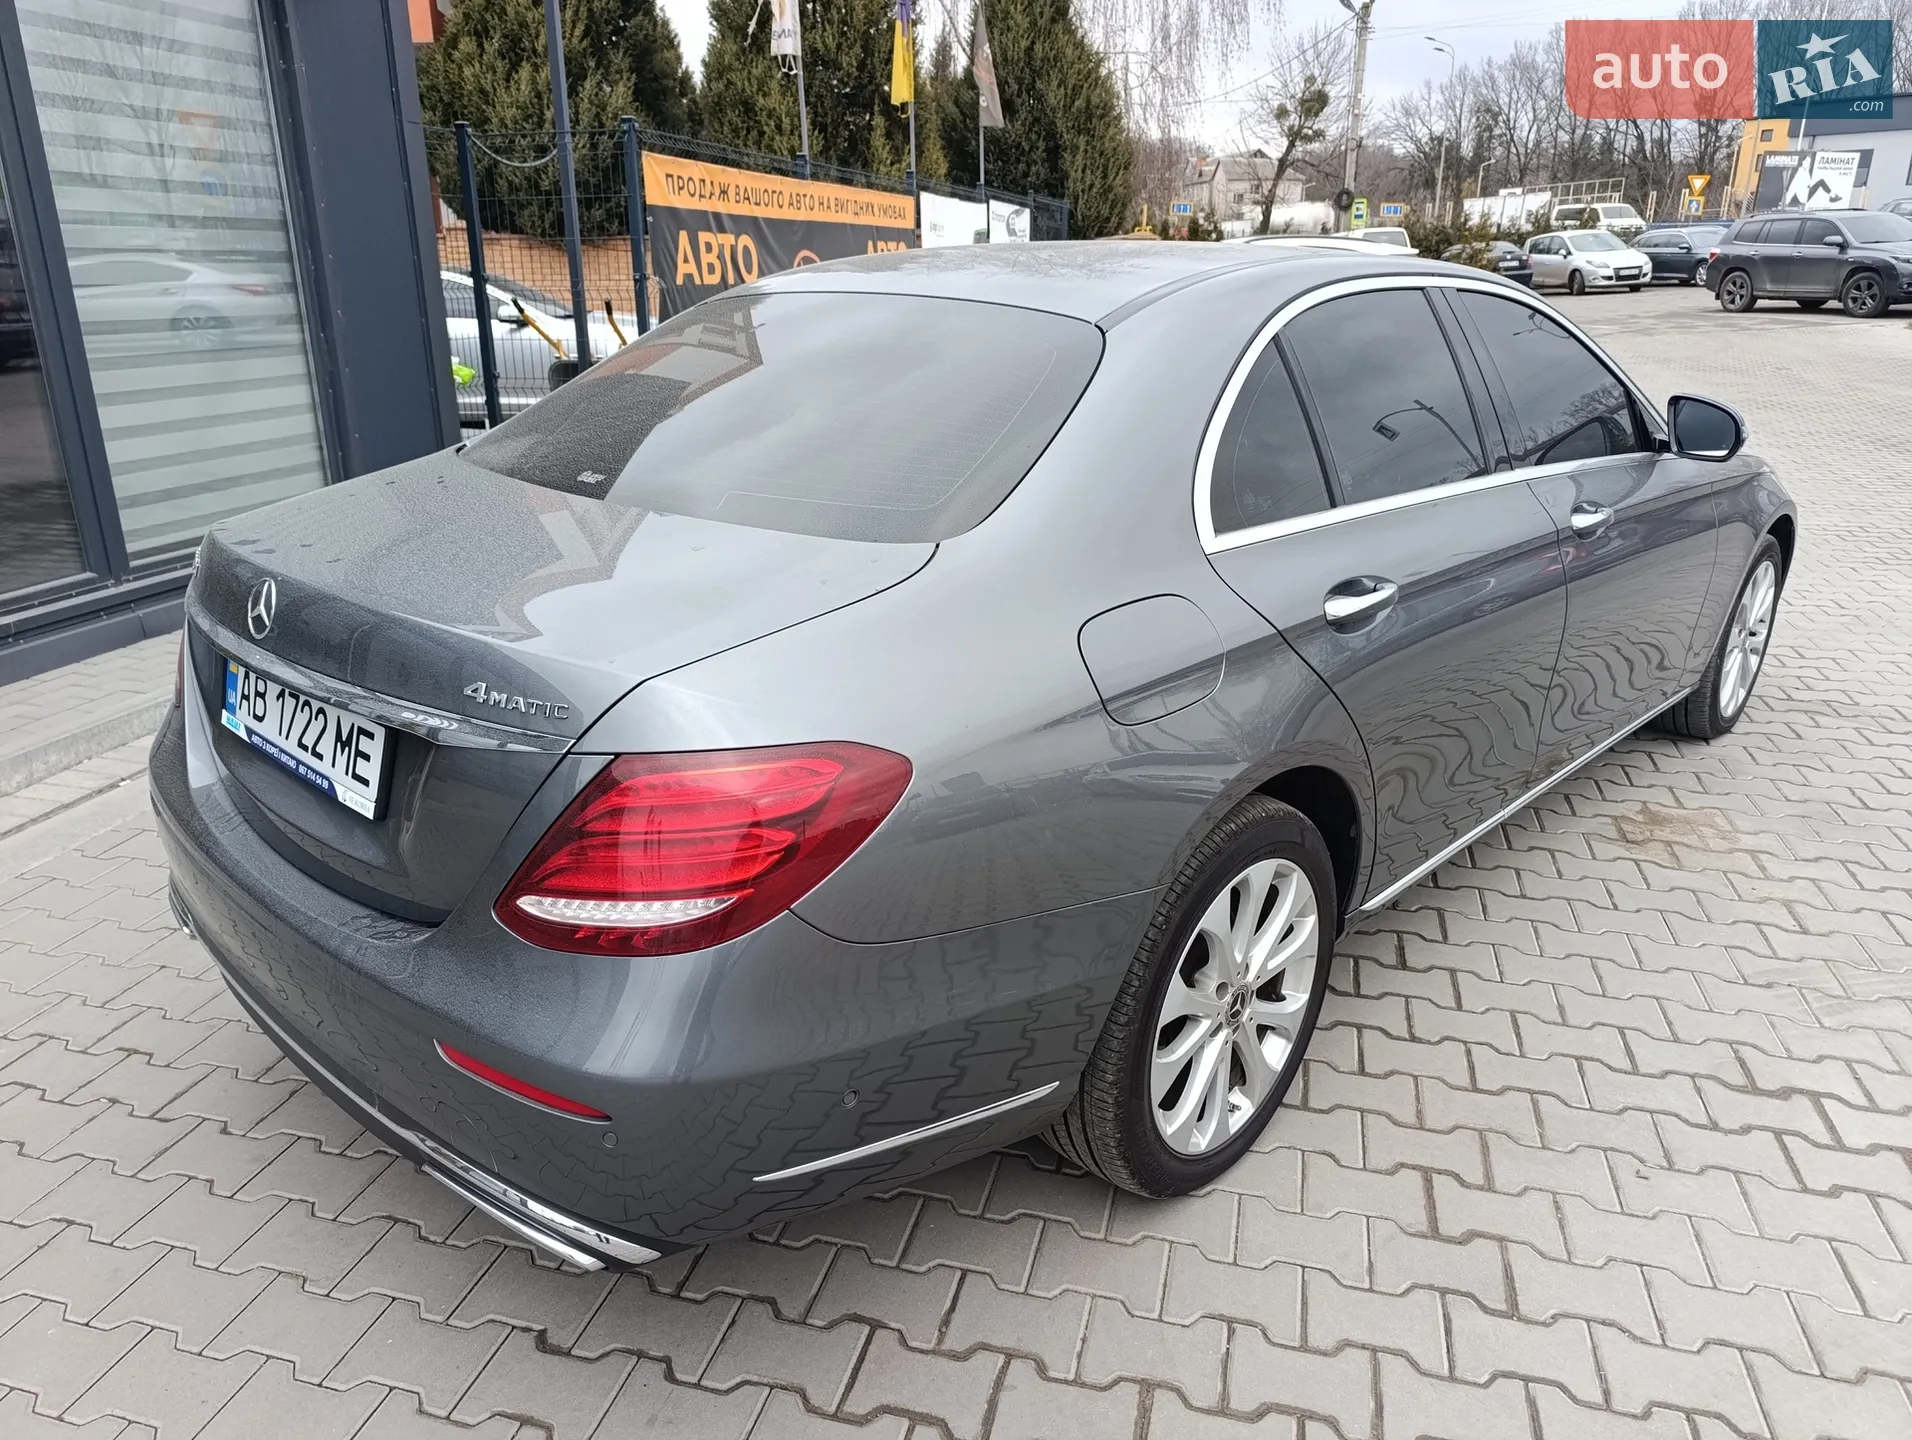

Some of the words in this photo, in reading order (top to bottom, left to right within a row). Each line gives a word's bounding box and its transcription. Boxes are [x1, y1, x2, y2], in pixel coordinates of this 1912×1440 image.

[1818, 156, 1856, 166] ЛАМІНАТ
[665, 173, 730, 204] ПРОДАЖ
[735, 184, 784, 209] ВАШОГО
[788, 191, 815, 213] АВТО
[818, 196, 832, 212] НА
[834, 197, 875, 219] ВИГІДНИХ
[877, 204, 907, 220] УМОВАХ
[675, 229, 759, 286] АВТО
[463, 681, 569, 719] 4MATIC
[238, 669, 268, 723] AB
[276, 687, 328, 762] 1722
[331, 715, 376, 788] ME
